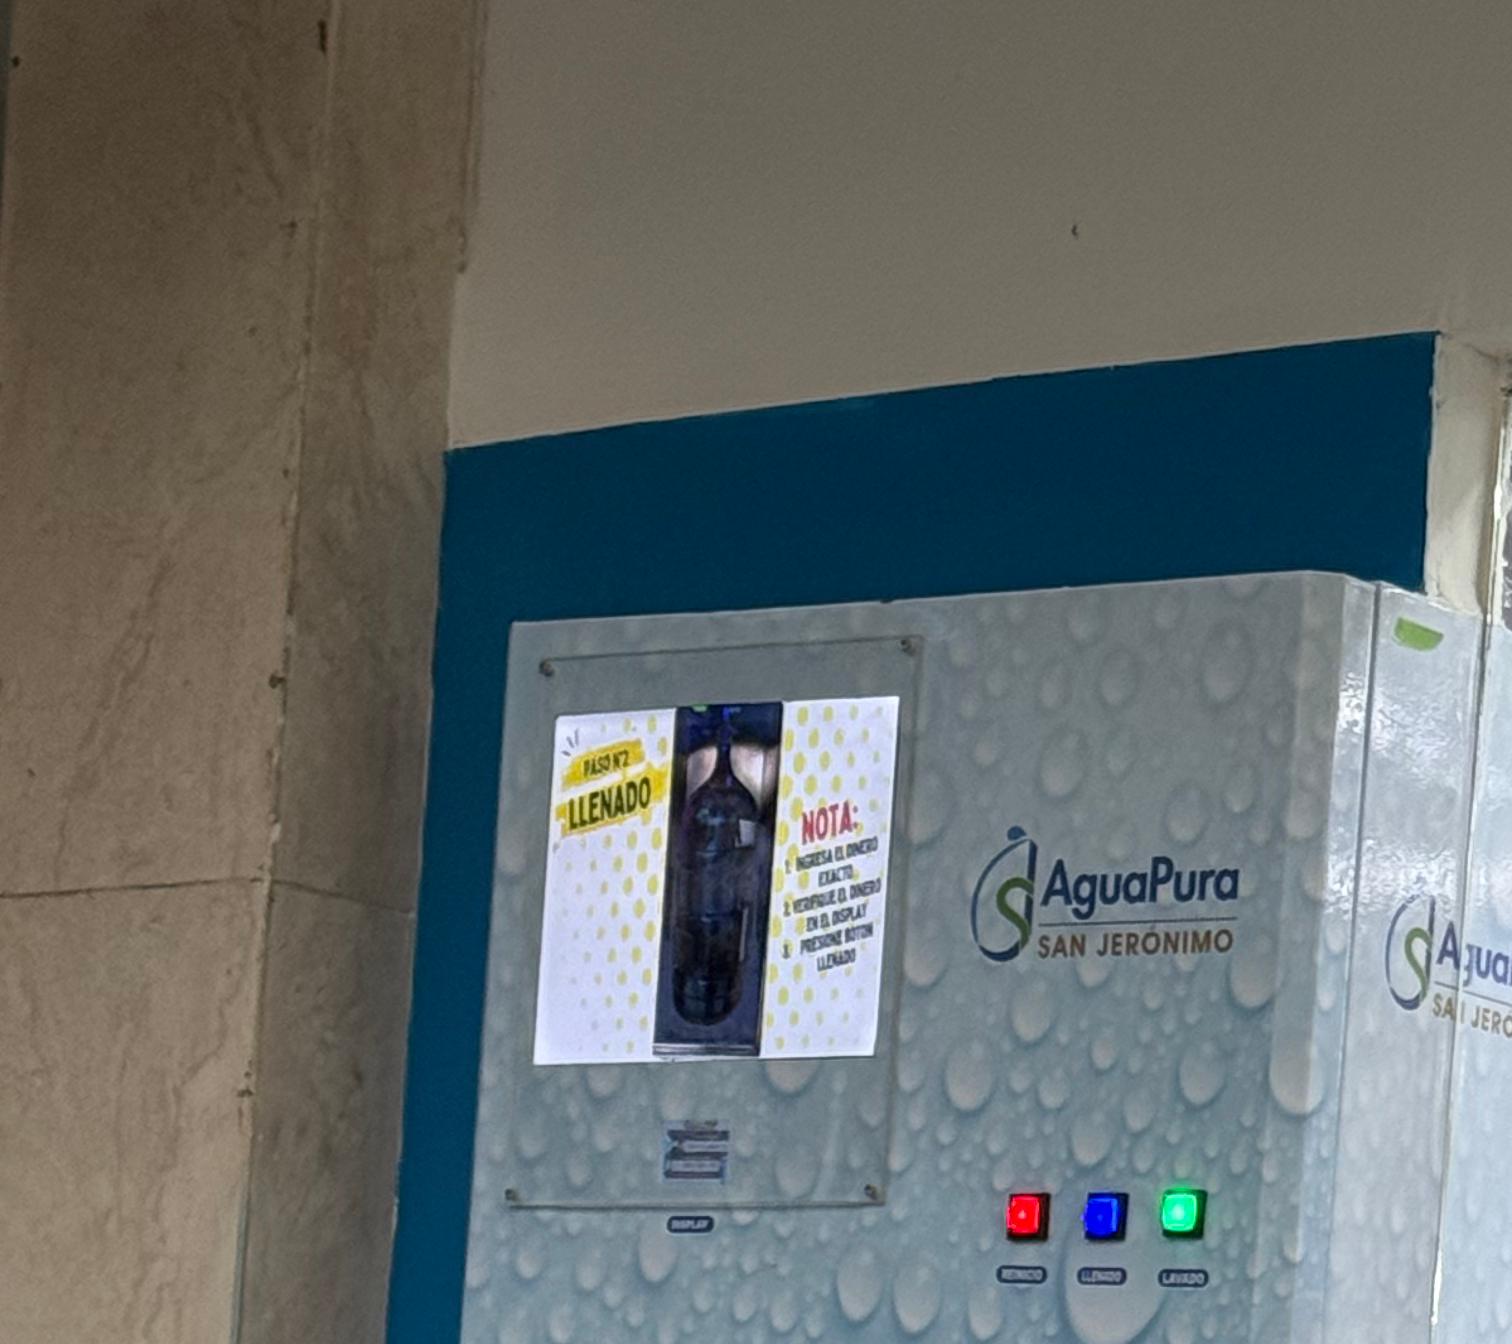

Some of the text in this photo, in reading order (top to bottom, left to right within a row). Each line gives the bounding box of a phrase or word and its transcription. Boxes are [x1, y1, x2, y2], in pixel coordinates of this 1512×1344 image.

[568, 776, 651, 830] LLENADO
[801, 801, 859, 845] NOTA:
[818, 864, 853, 887] EXACTO
[1040, 856, 1240, 920] AguaPura
[850, 878, 882, 900] DINERO
[806, 903, 867, 932] EN EL DISPLAY
[1037, 934, 1087, 959] SAN
[816, 948, 856, 972] LLENADO
[1162, 1273, 1205, 1285] LAVADO
